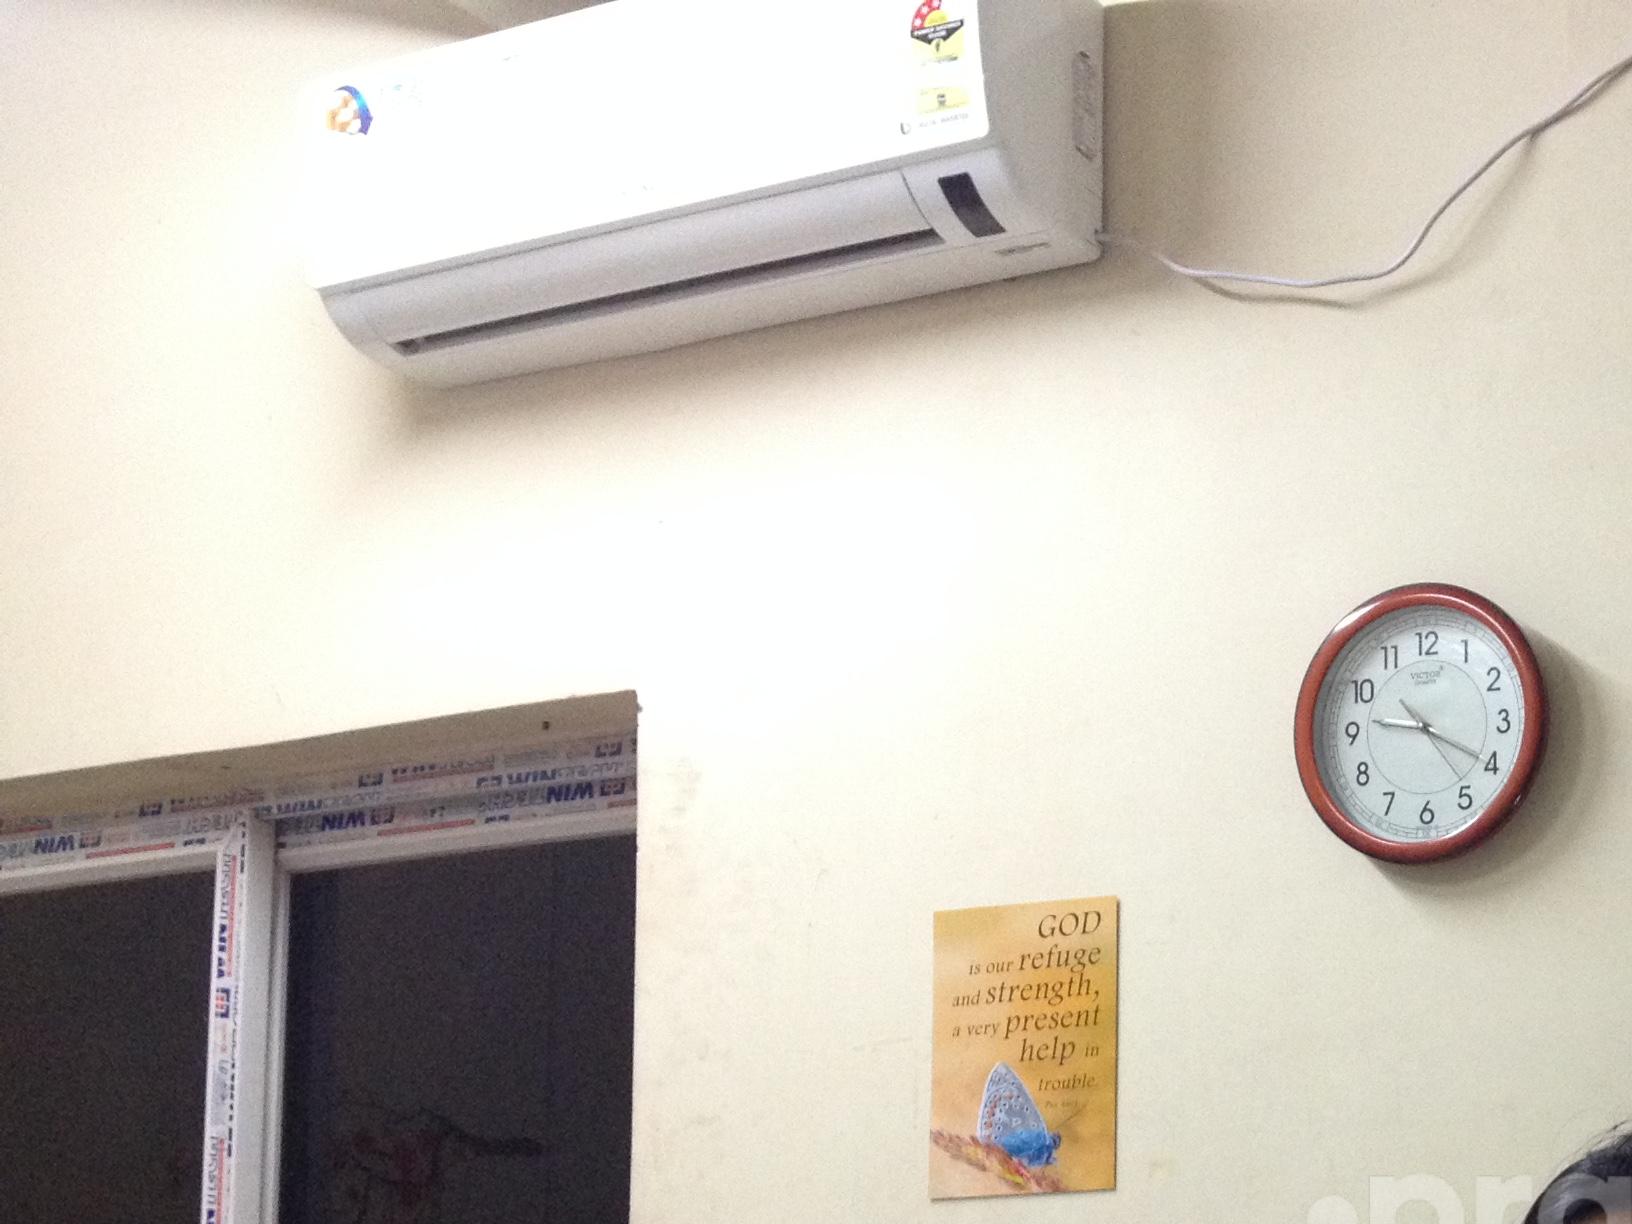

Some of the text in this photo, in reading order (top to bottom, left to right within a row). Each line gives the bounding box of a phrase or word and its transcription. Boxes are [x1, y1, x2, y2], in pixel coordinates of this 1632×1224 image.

[1415, 631, 1439, 656] 12
[1461, 639, 1469, 663] 1
[1380, 645, 1399, 670] 11
[1351, 679, 1375, 703] 10
[1486, 667, 1501, 692] 2
[1345, 721, 1360, 746] 9
[1496, 708, 1511, 734] 3
[1356, 762, 1370, 786] 8
[1484, 751, 1499, 775] 4
[1383, 792, 1395, 816] 7
[1457, 785, 1473, 810] 5
[1419, 800, 1435, 825] 6
[1038, 910, 1102, 939] GOD
[969, 944, 1102, 975] is our refuge
[952, 973, 1100, 1007] and strength,
[952, 1006, 1100, 1039] a very present
[1019, 1038, 1100, 1066] help in
